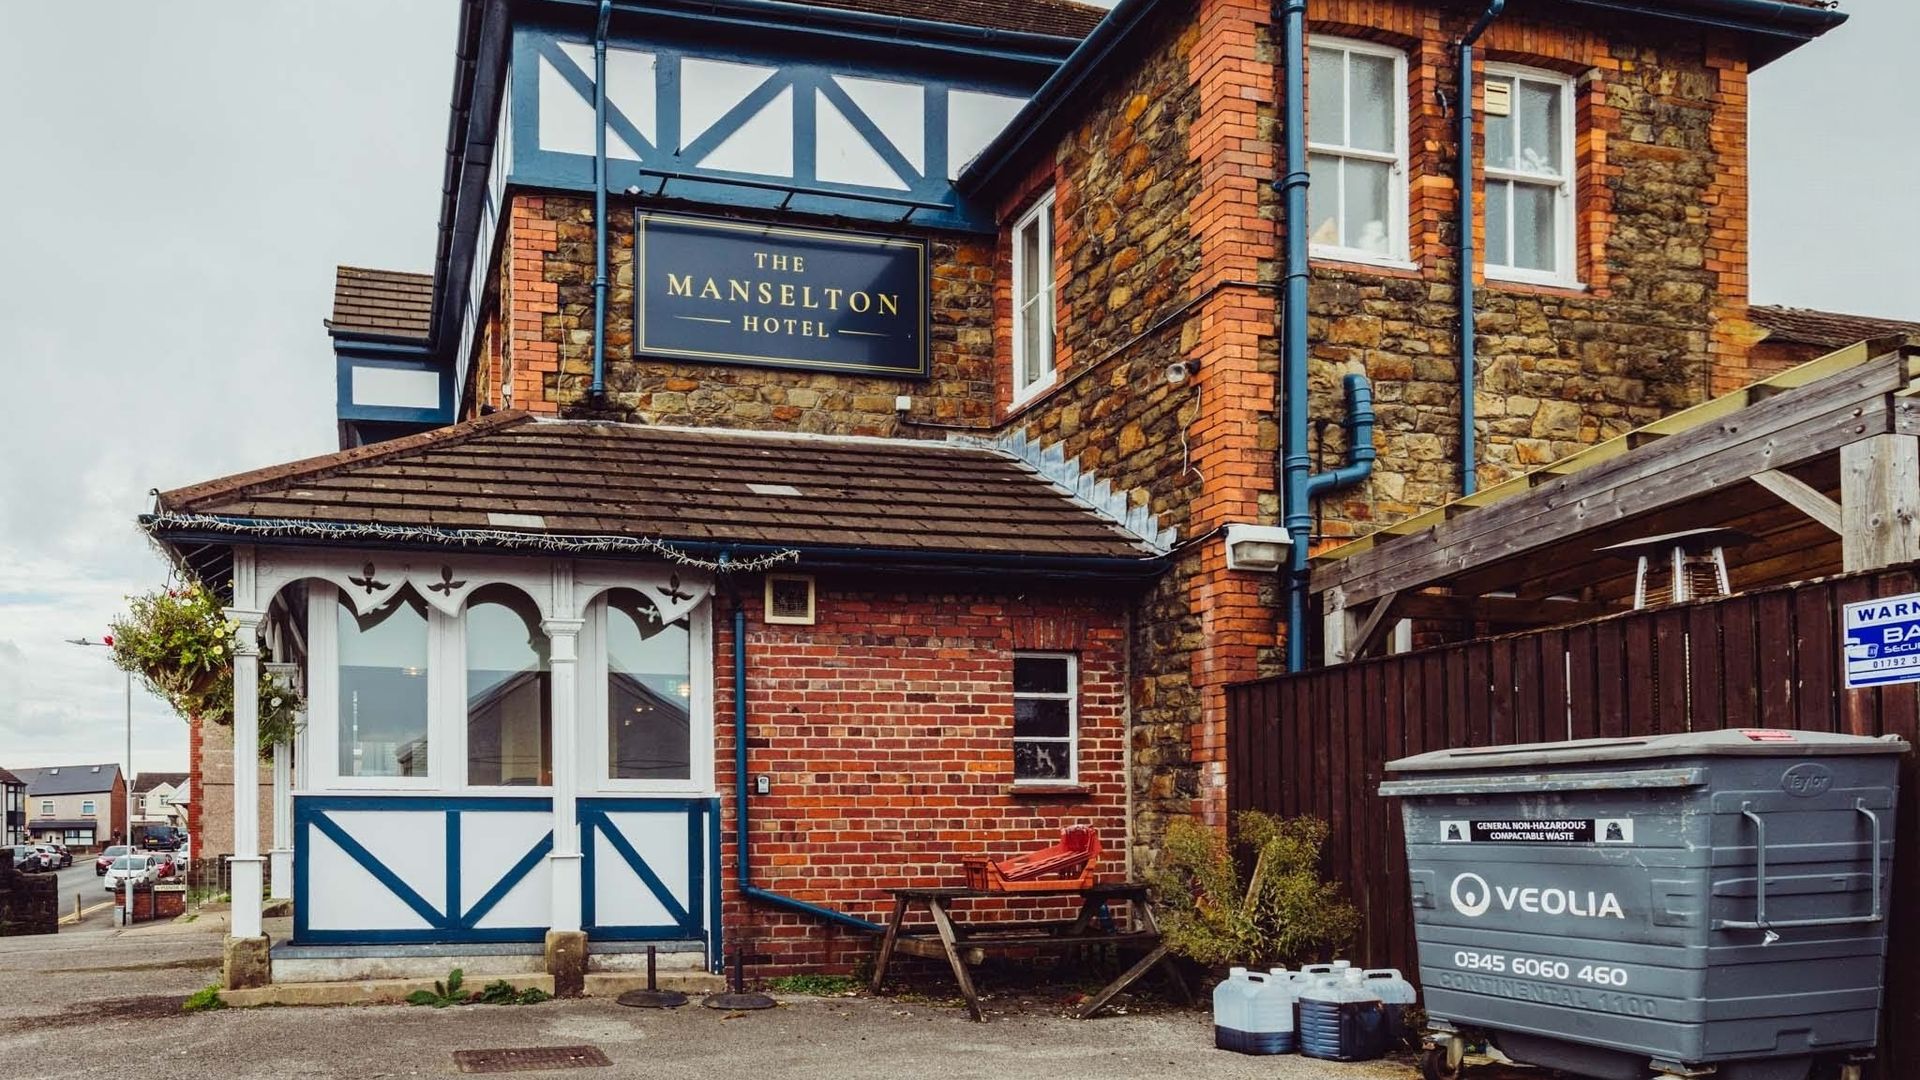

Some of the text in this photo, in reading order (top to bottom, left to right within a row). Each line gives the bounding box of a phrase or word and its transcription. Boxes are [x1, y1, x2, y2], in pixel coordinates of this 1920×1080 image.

[753, 251, 806, 273] THE
[667, 273, 899, 316] MANSELTON
[743, 315, 830, 338] HOTEL
[1884, 642, 1920, 654] SECU
[1873, 658, 1906, 669] 01792
[1787, 772, 1829, 793] Taylor
[1477, 821, 1587, 830] GENERAL NON-HAZARDOUS
[1490, 831, 1575, 841] COMPACTABLE WASTE
[1495, 886, 1626, 920] VEOLIA
[1454, 951, 1629, 986] 0345 6060 460
[1439, 972, 1658, 1017] CONTINENTAL 1100
